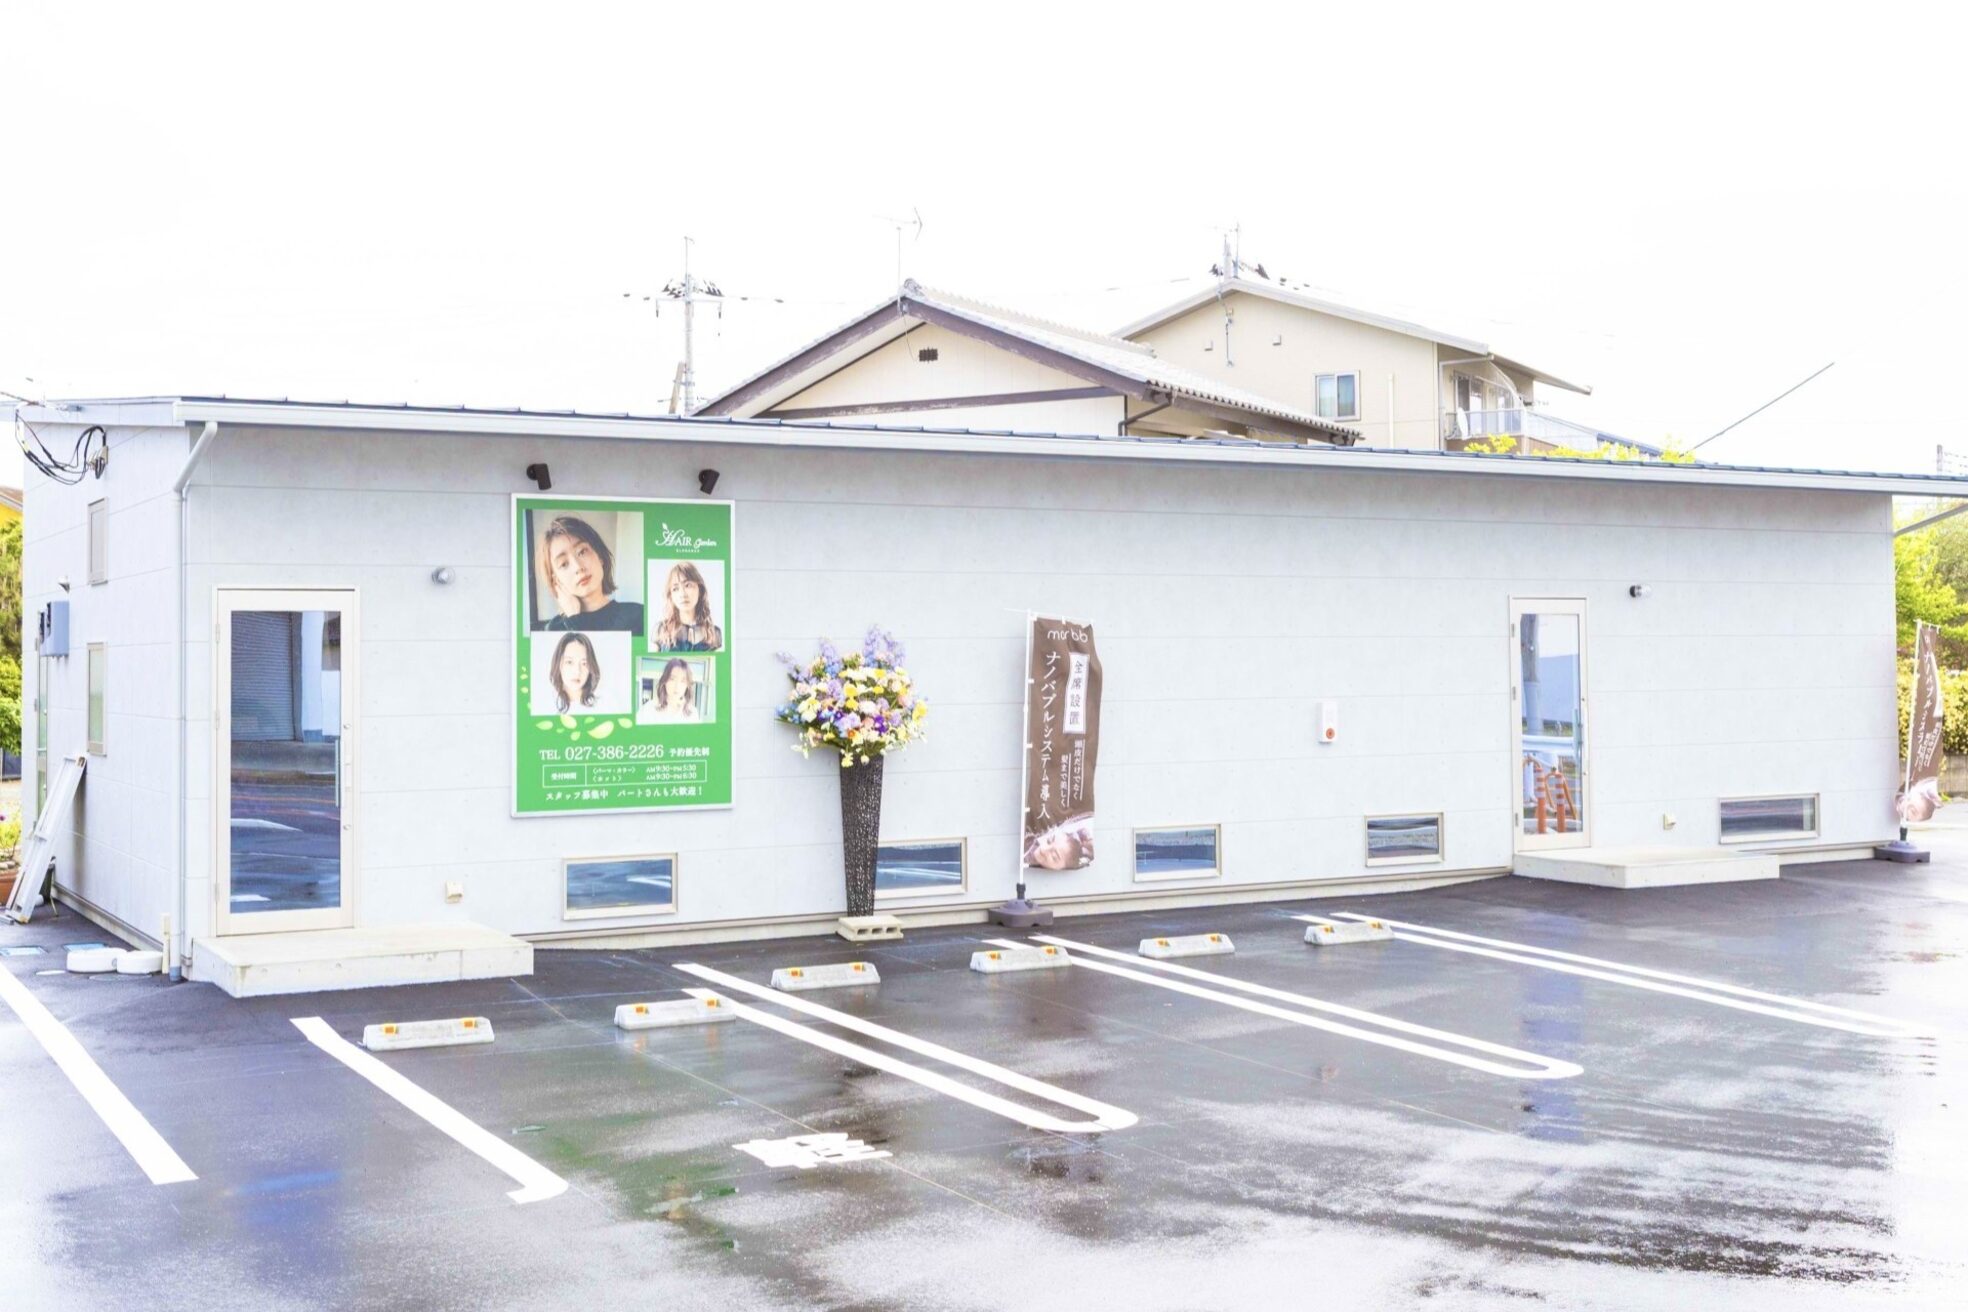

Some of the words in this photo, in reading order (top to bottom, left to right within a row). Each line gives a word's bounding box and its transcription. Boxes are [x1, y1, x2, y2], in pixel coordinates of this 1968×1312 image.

[539, 750, 561, 761] TEL
[565, 744, 664, 760] 027-386-2226
[1037, 651, 1061, 819] ナノバブルシステム導入
